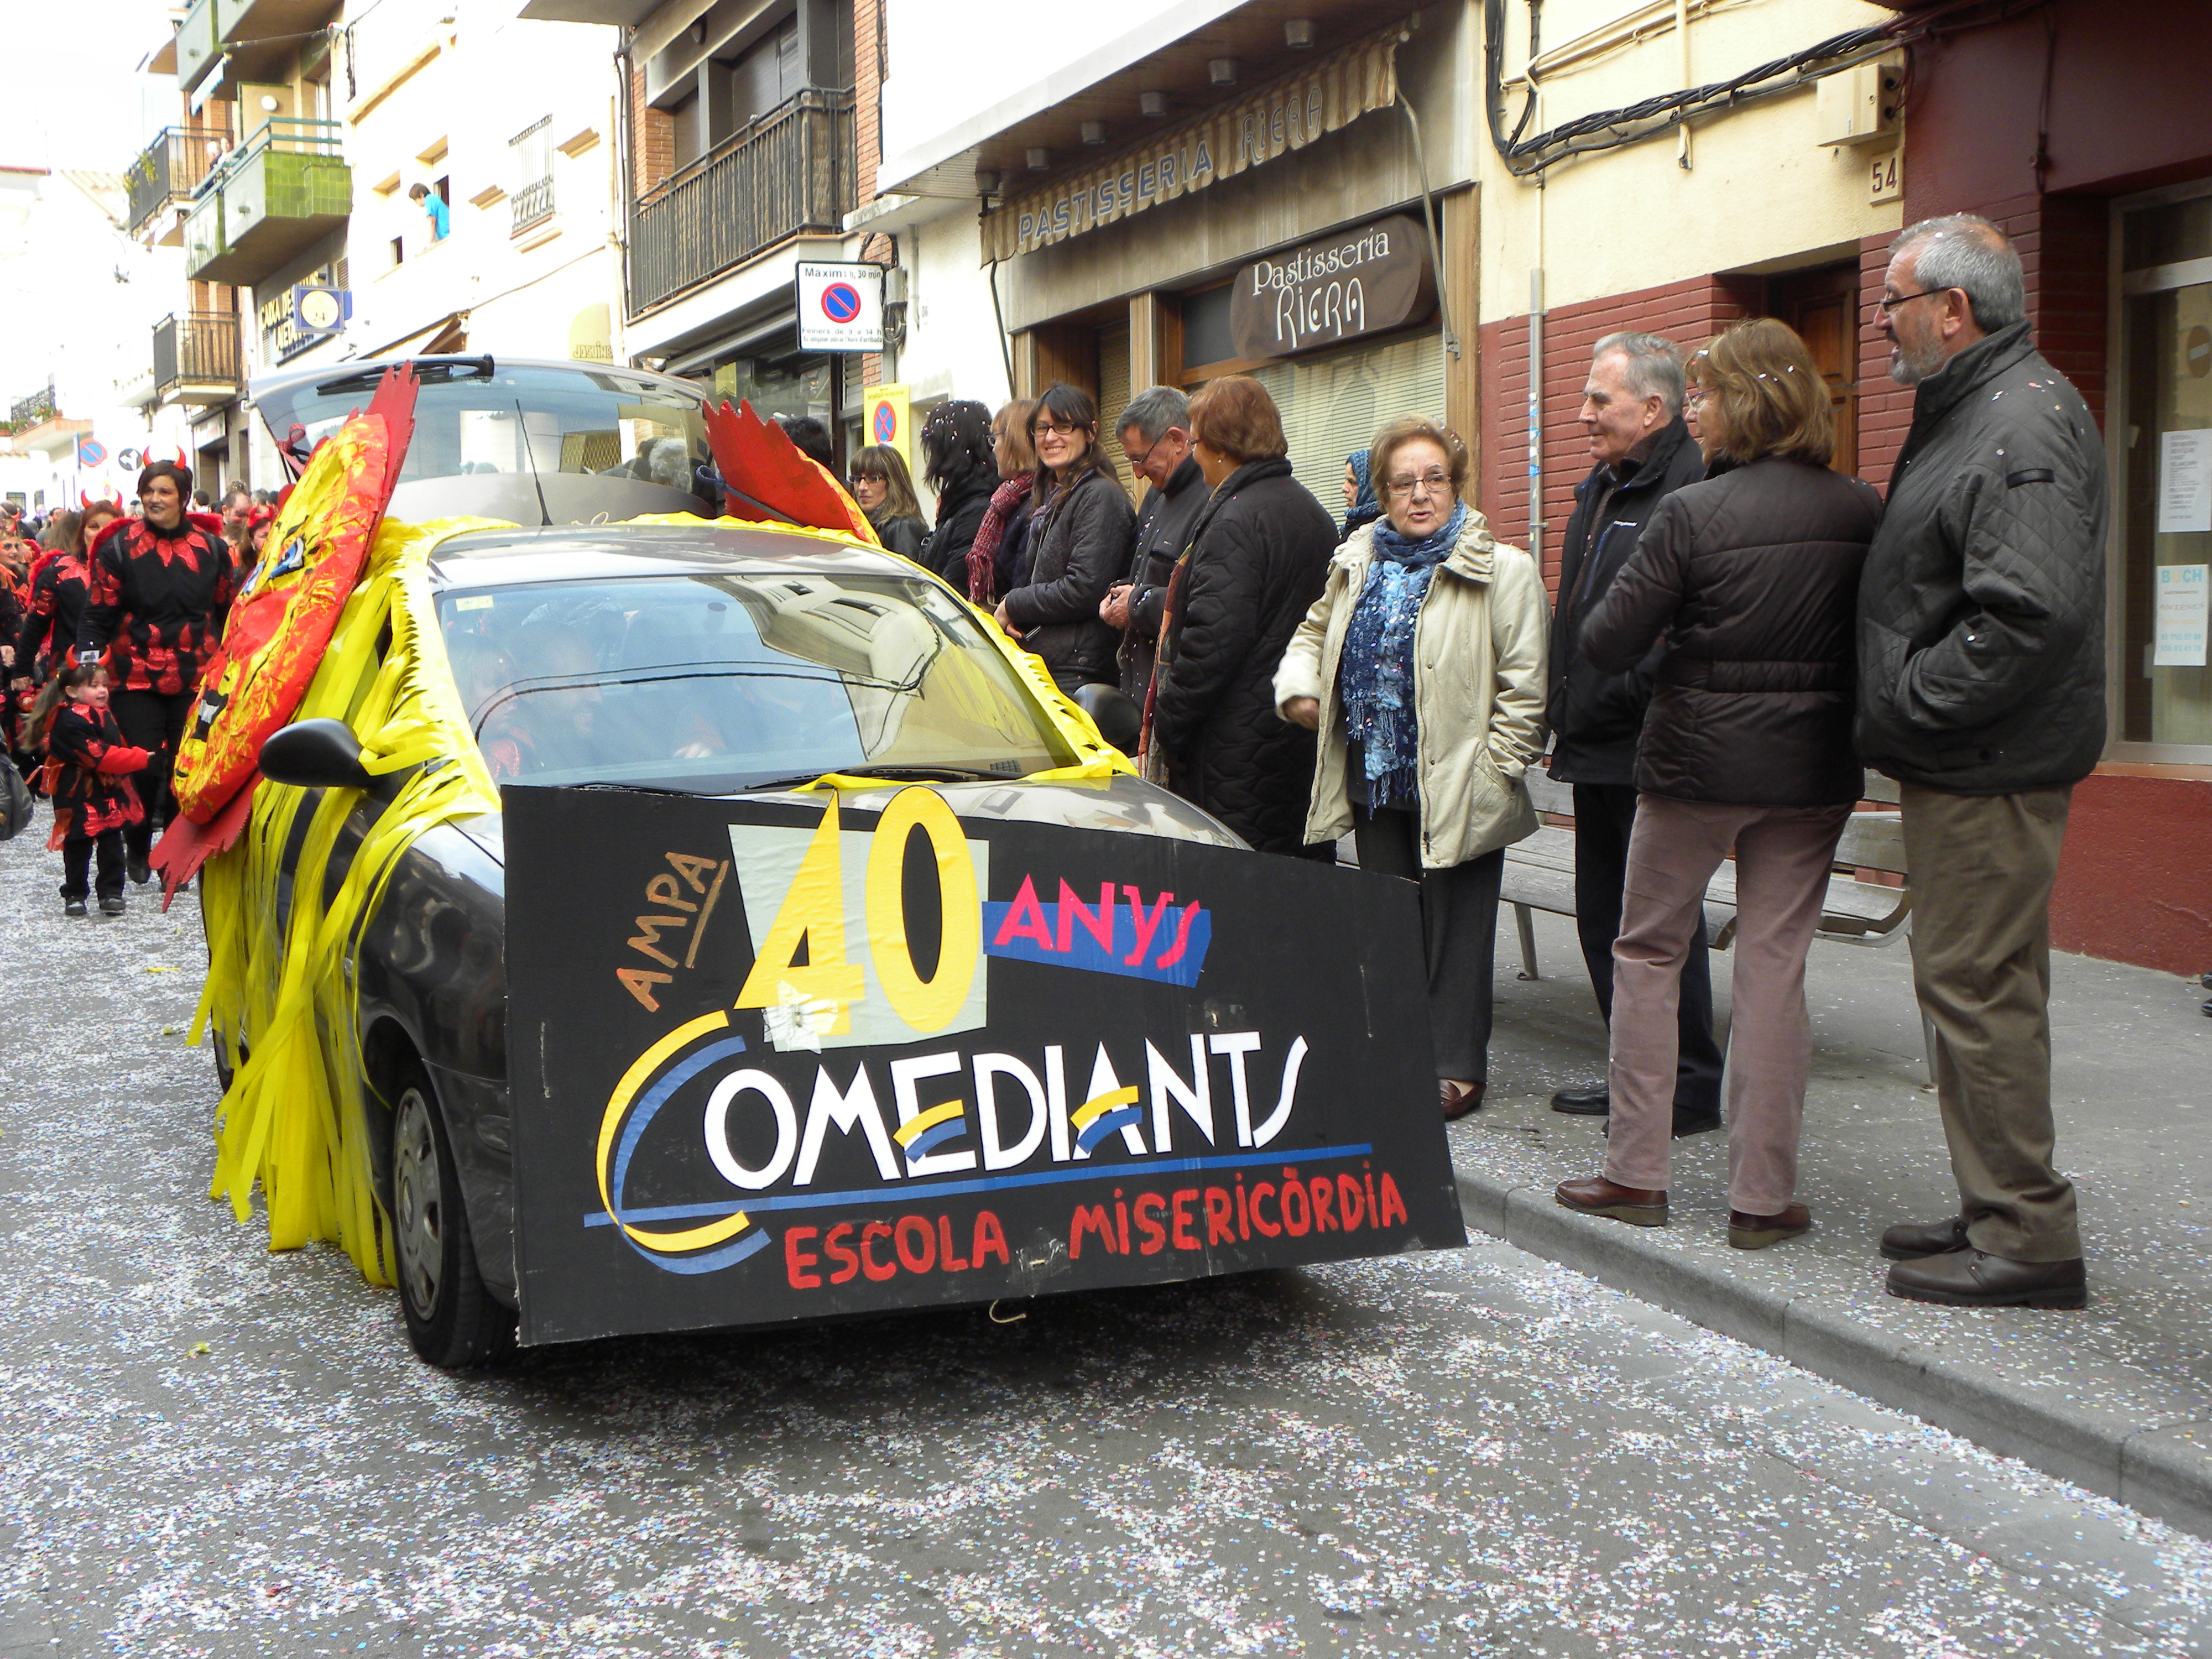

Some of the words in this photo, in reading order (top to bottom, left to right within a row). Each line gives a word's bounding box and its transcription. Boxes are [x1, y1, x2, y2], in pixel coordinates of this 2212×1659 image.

[1019, 143, 1213, 243] PASTISSERIA
[1872, 158, 1897, 194] 54
[805, 268, 842, 278] Màxim
[1252, 229, 1390, 296] Pastisseria
[260, 298, 281, 331] CAIXA
[615, 851, 717, 1012] AMPA
[733, 785, 980, 1037] 40
[994, 873, 1201, 970] ANYS
[596, 1010, 1310, 1275] COMEDIANTS
[784, 1211, 1009, 1290] ESCOLA
